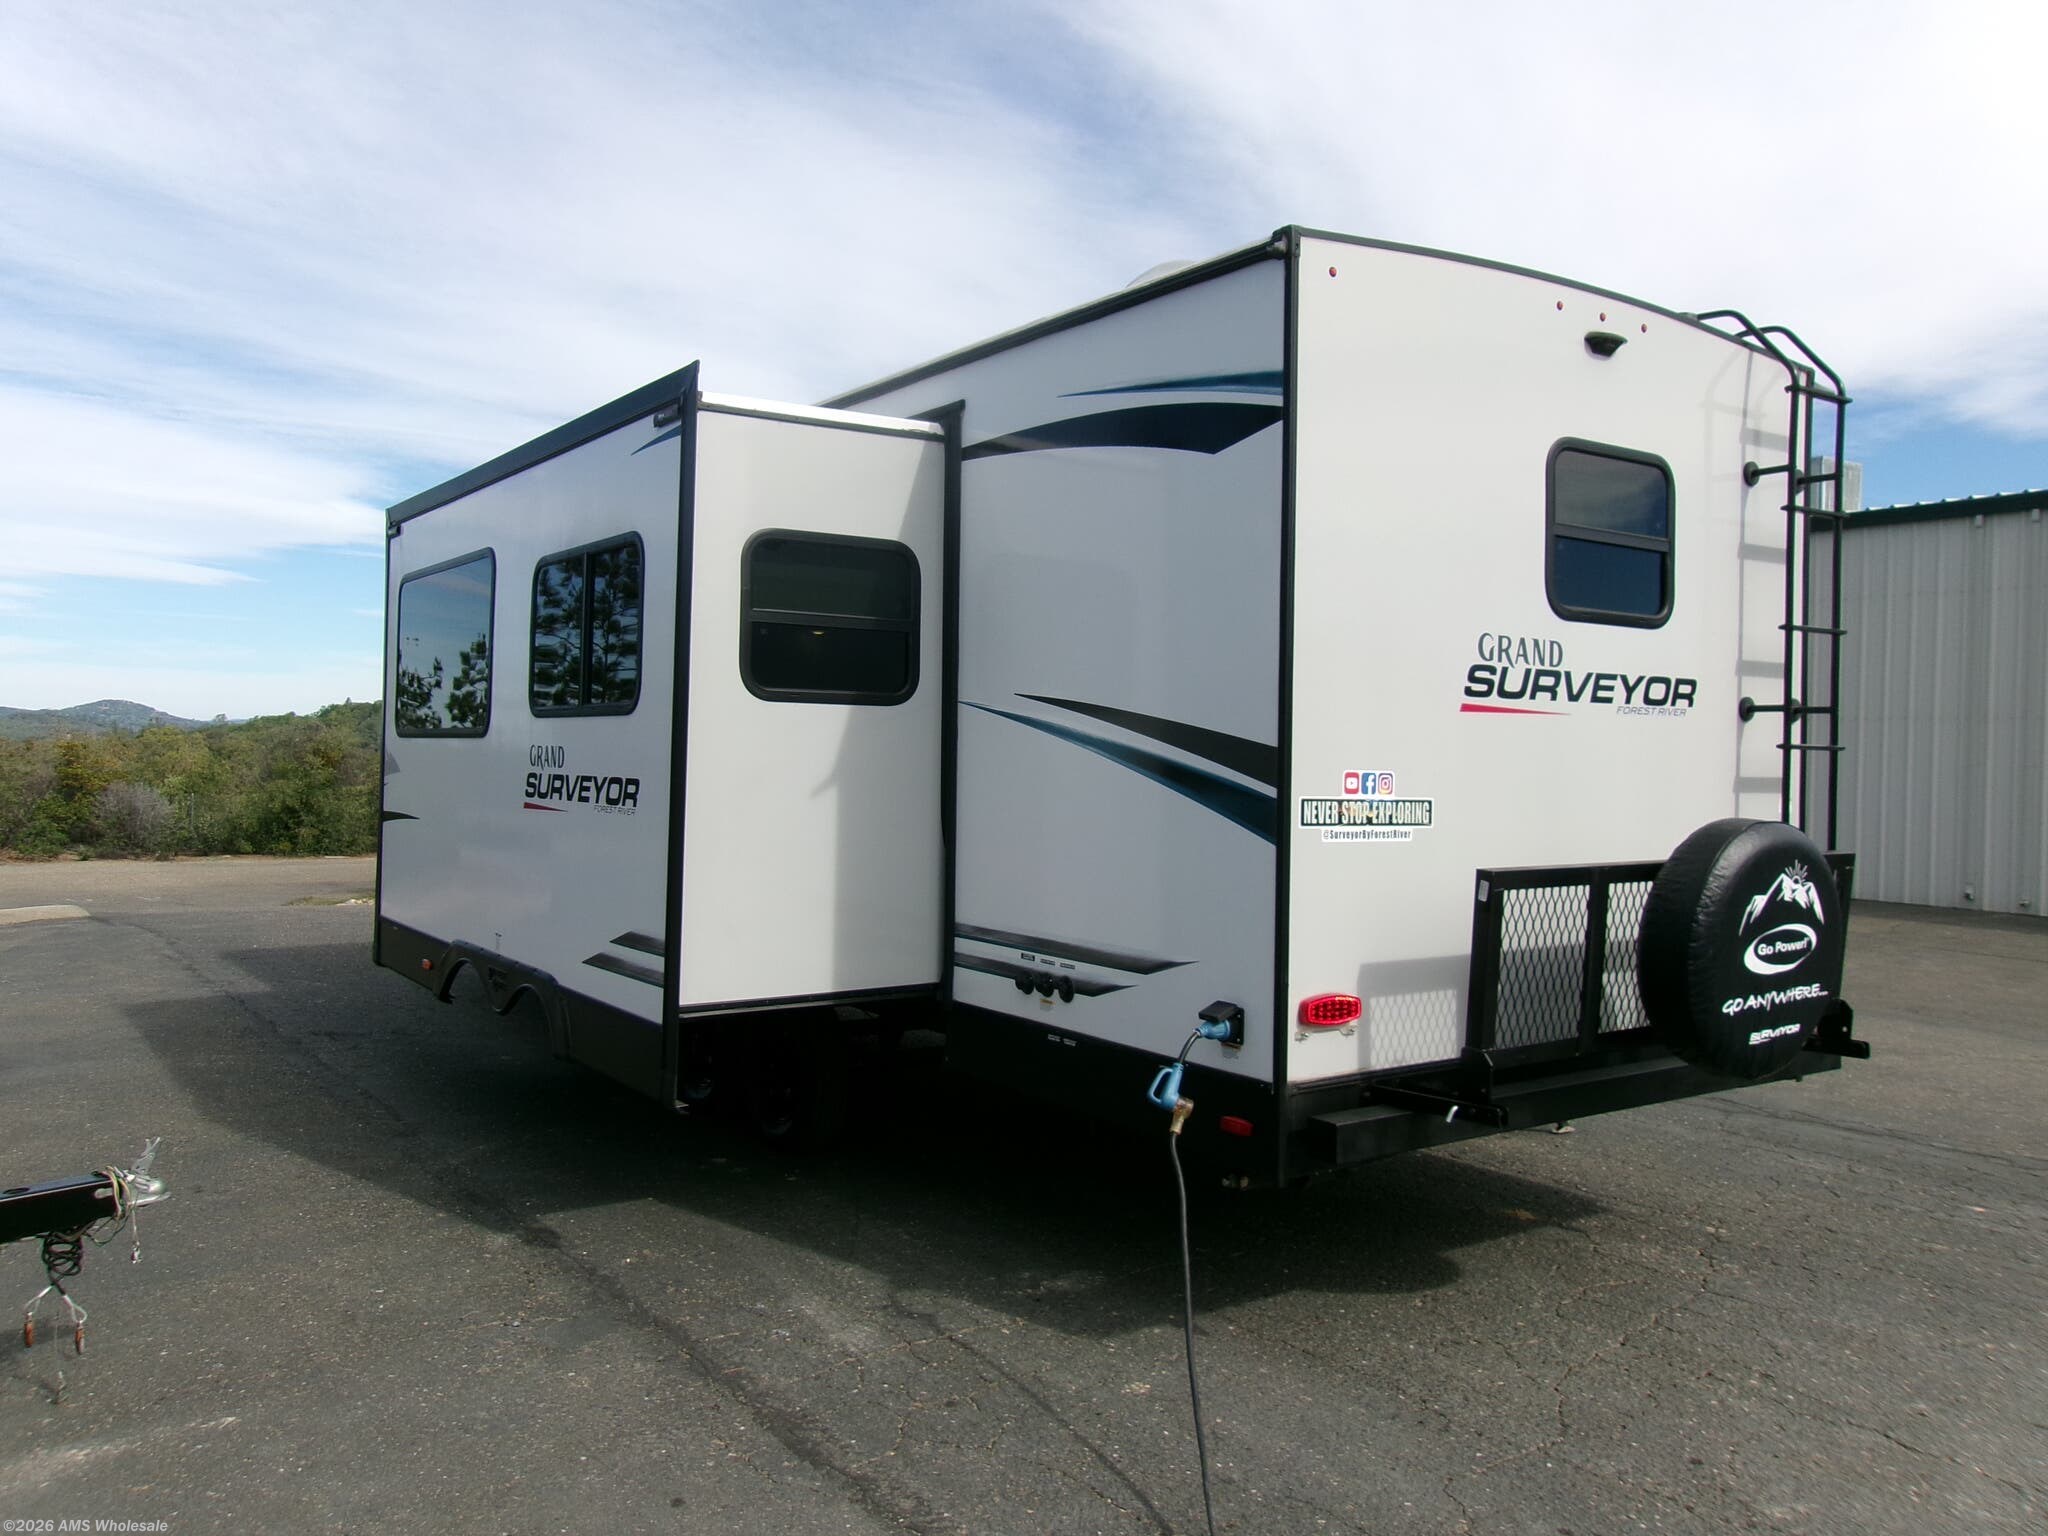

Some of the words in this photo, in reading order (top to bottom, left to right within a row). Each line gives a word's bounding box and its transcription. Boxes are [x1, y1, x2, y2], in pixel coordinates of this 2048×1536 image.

[1477, 632, 1563, 668] GRAND
[1463, 664, 1698, 708] SURVEYOR
[1616, 705, 1658, 716] FOREST
[1658, 707, 1688, 717] RIVER
[529, 744, 565, 770] GRAND
[525, 772, 640, 808] SURVEYOR
[1303, 801, 1339, 824] NEVER
[1341, 801, 1370, 824] STOP
[1372, 801, 1430, 824] EXPLORING
[1757, 943, 1774, 956] Go
[1722, 997, 1744, 1016] GO
